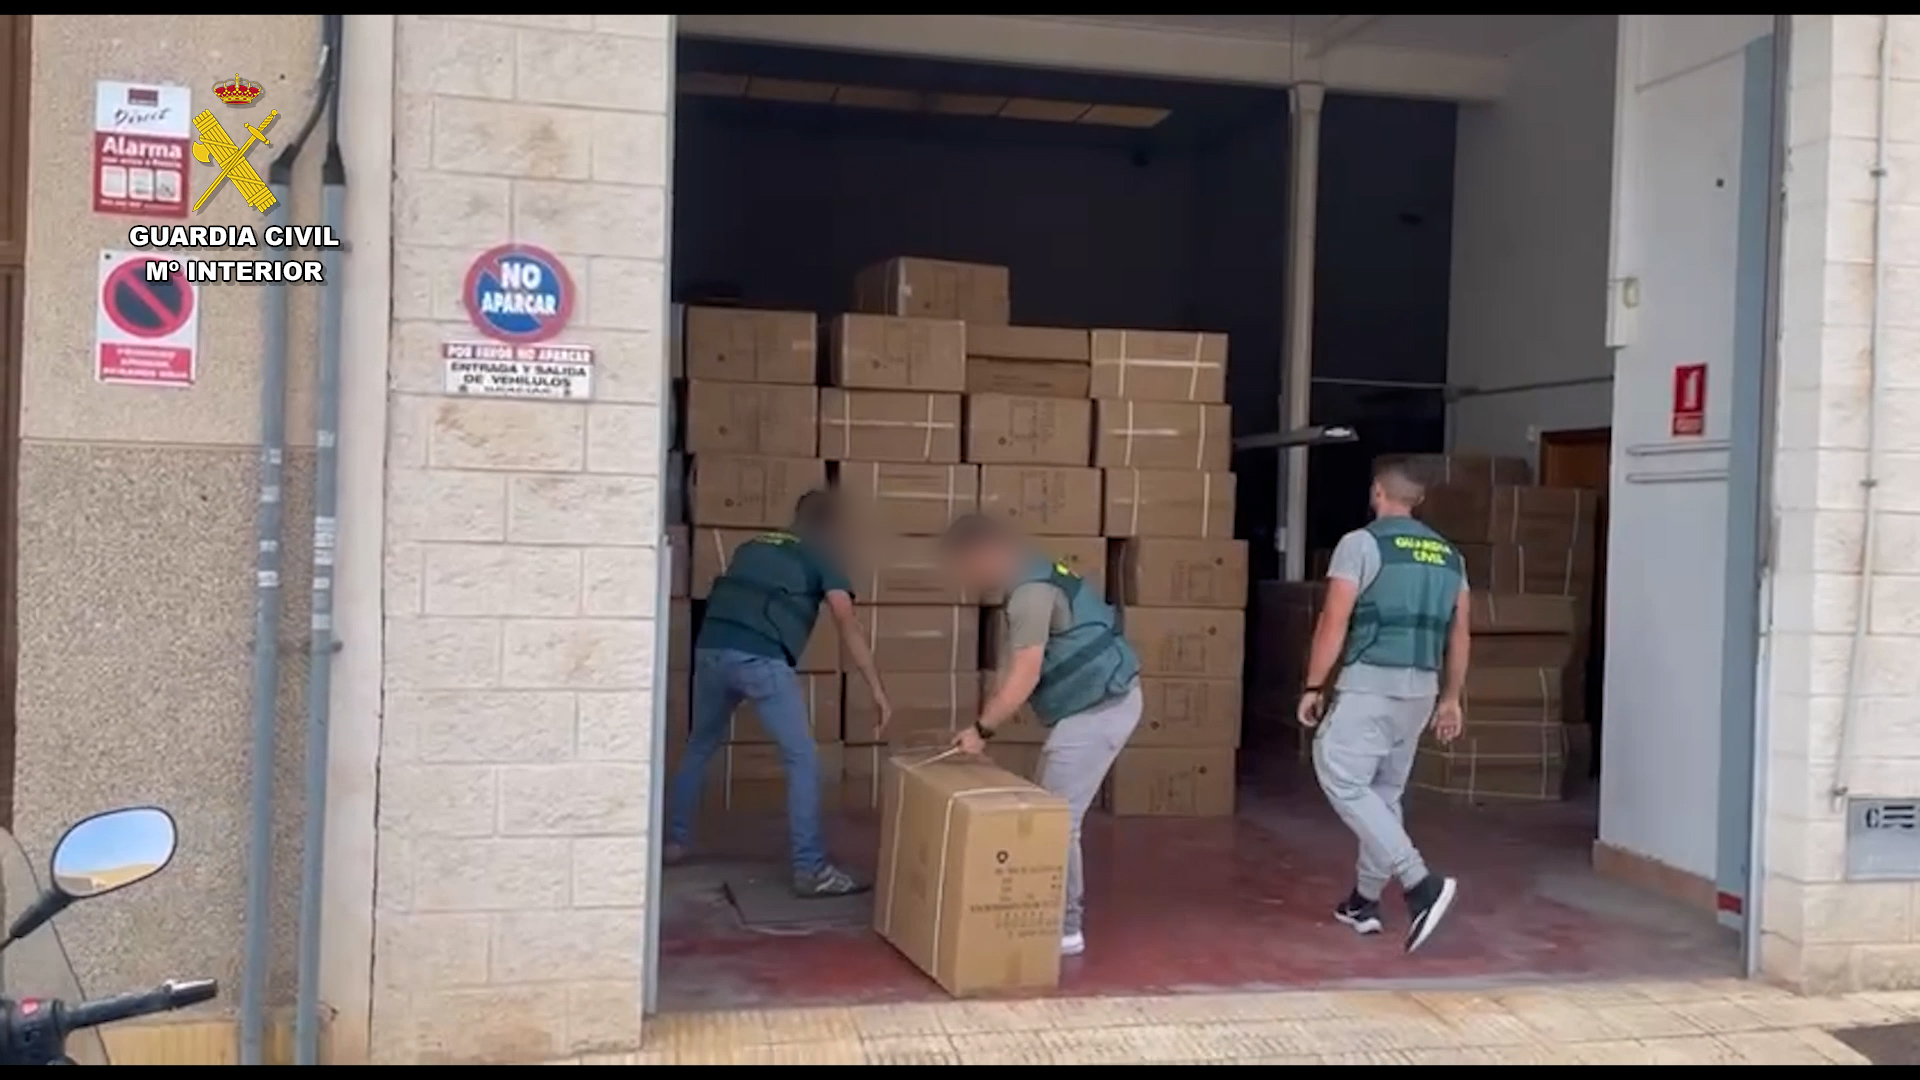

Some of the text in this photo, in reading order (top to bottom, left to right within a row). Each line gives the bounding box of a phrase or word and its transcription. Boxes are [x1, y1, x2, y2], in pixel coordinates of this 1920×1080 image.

[102, 136, 182, 160] Alarma
[501, 261, 542, 289] NO
[481, 291, 556, 315] APARCAR
[451, 362, 587, 376] ENTRADA Y SALIDA
[464, 374, 484, 384] DE
[1412, 550, 1447, 566] CIVIL
